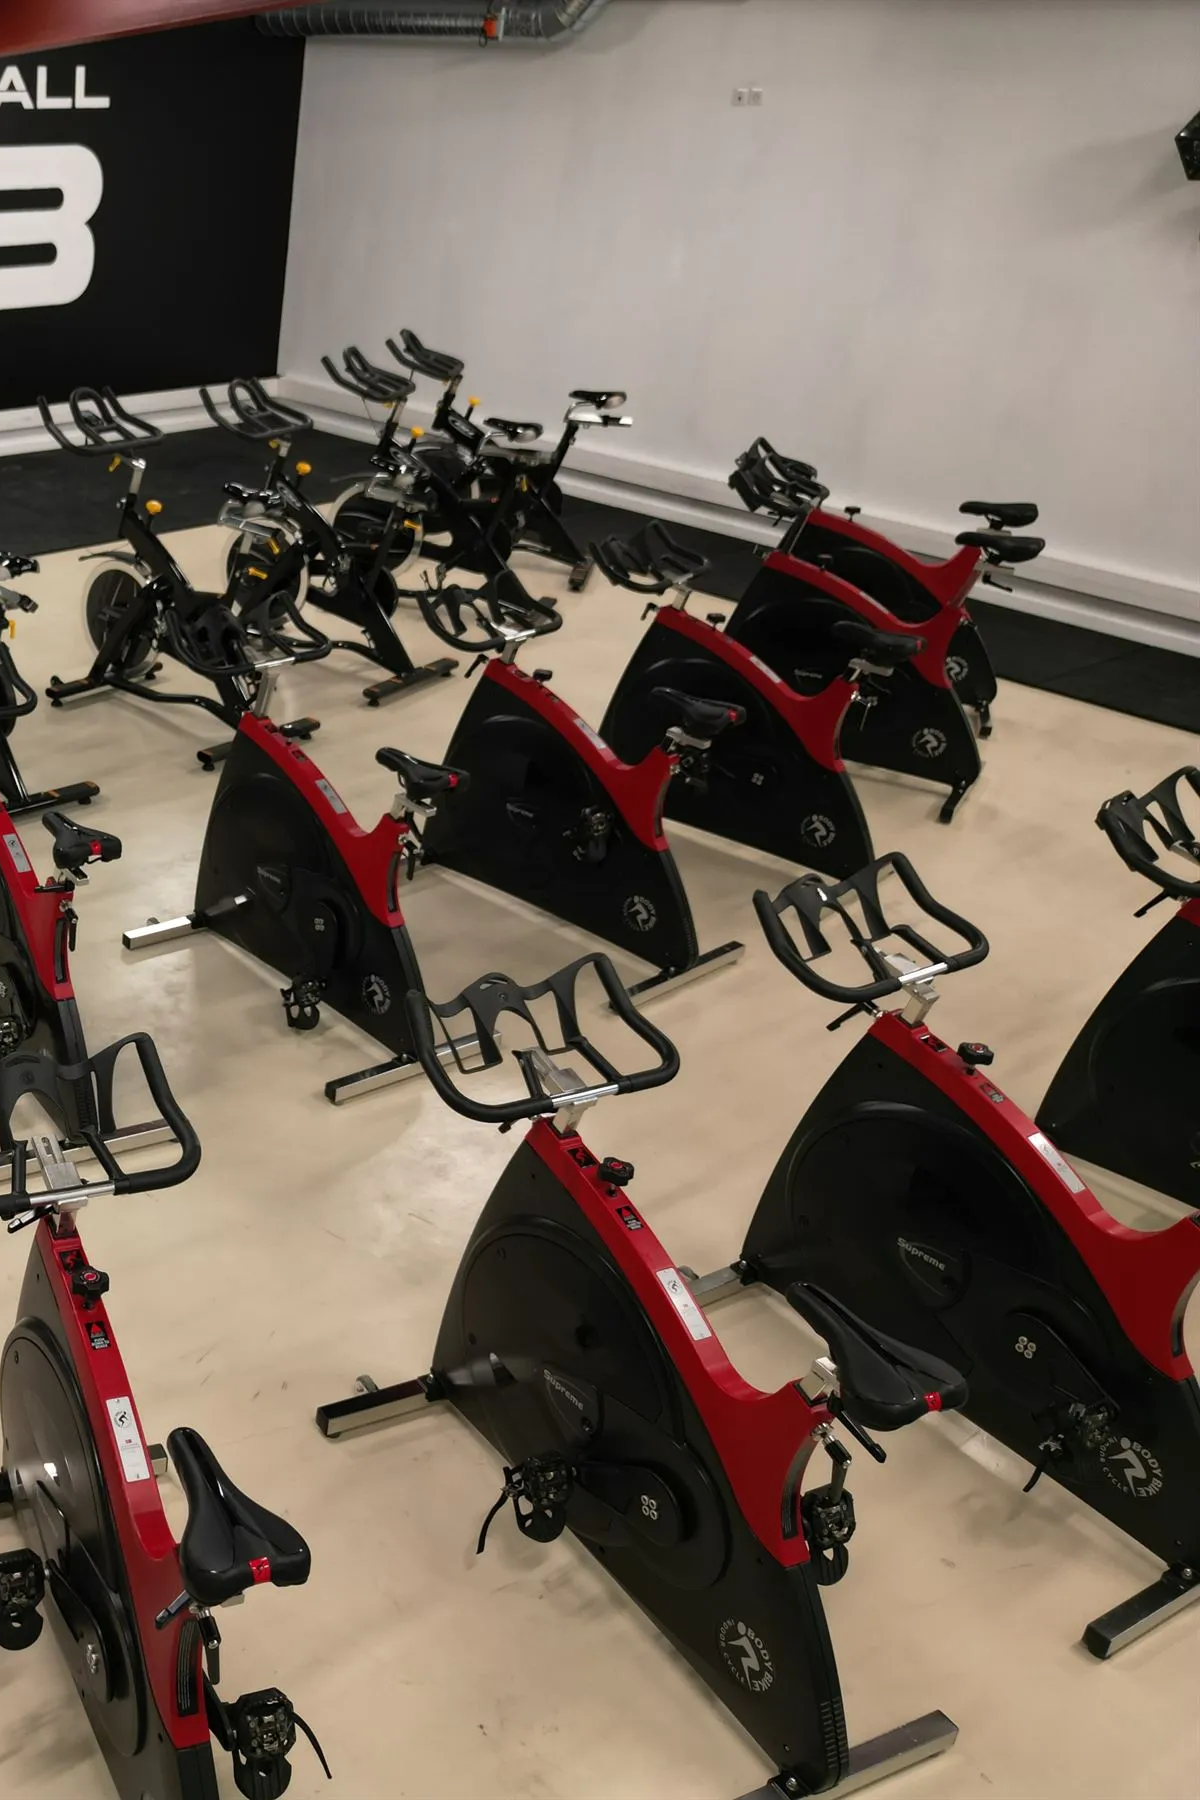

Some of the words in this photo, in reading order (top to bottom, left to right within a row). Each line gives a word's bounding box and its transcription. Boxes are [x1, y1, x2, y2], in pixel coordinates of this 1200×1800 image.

[897, 1236, 946, 1271] Supreme
[543, 1368, 584, 1411] Supreme
[1131, 1441, 1164, 1479] BODY
[1136, 1477, 1163, 1497] BIKE
[746, 1627, 774, 1672] BODY
[751, 1671, 774, 1692] BIKE
